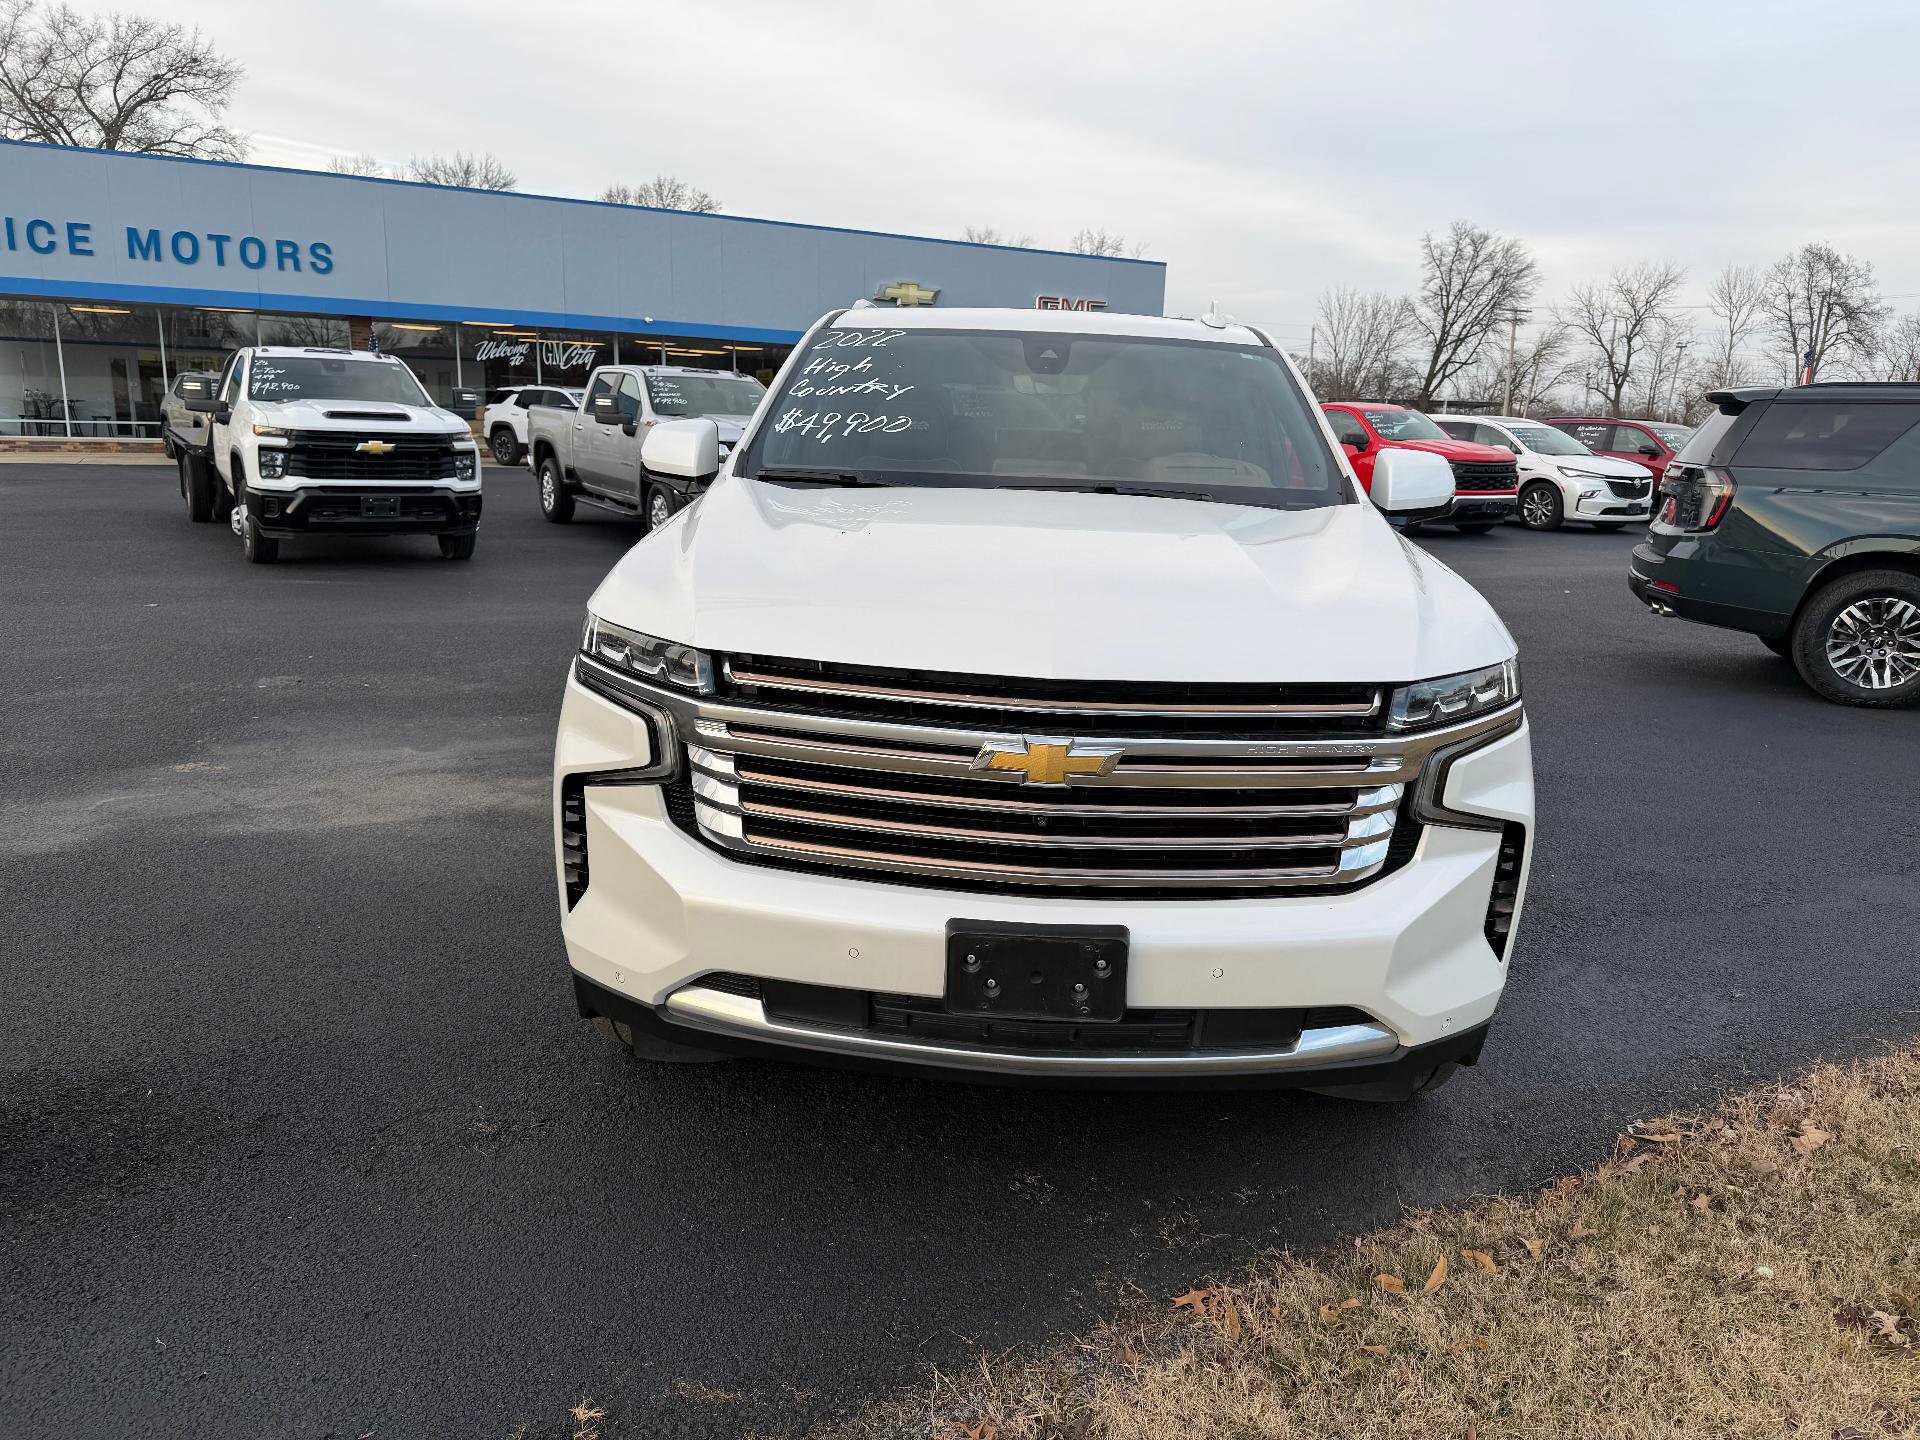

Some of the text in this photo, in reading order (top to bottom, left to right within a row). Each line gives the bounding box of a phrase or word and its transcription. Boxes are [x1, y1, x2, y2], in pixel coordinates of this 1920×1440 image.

[5, 216, 334, 275] ICE MOTORS
[1035, 295, 1108, 311] GMC
[811, 330, 907, 350] 2022
[475, 340, 597, 371] Welcome GM City
[509, 353, 525, 366] to
[803, 356, 873, 381] High
[788, 377, 915, 401] Country
[774, 407, 912, 444] $49,900
[1247, 745, 1377, 754] HIGH COUNTRY
